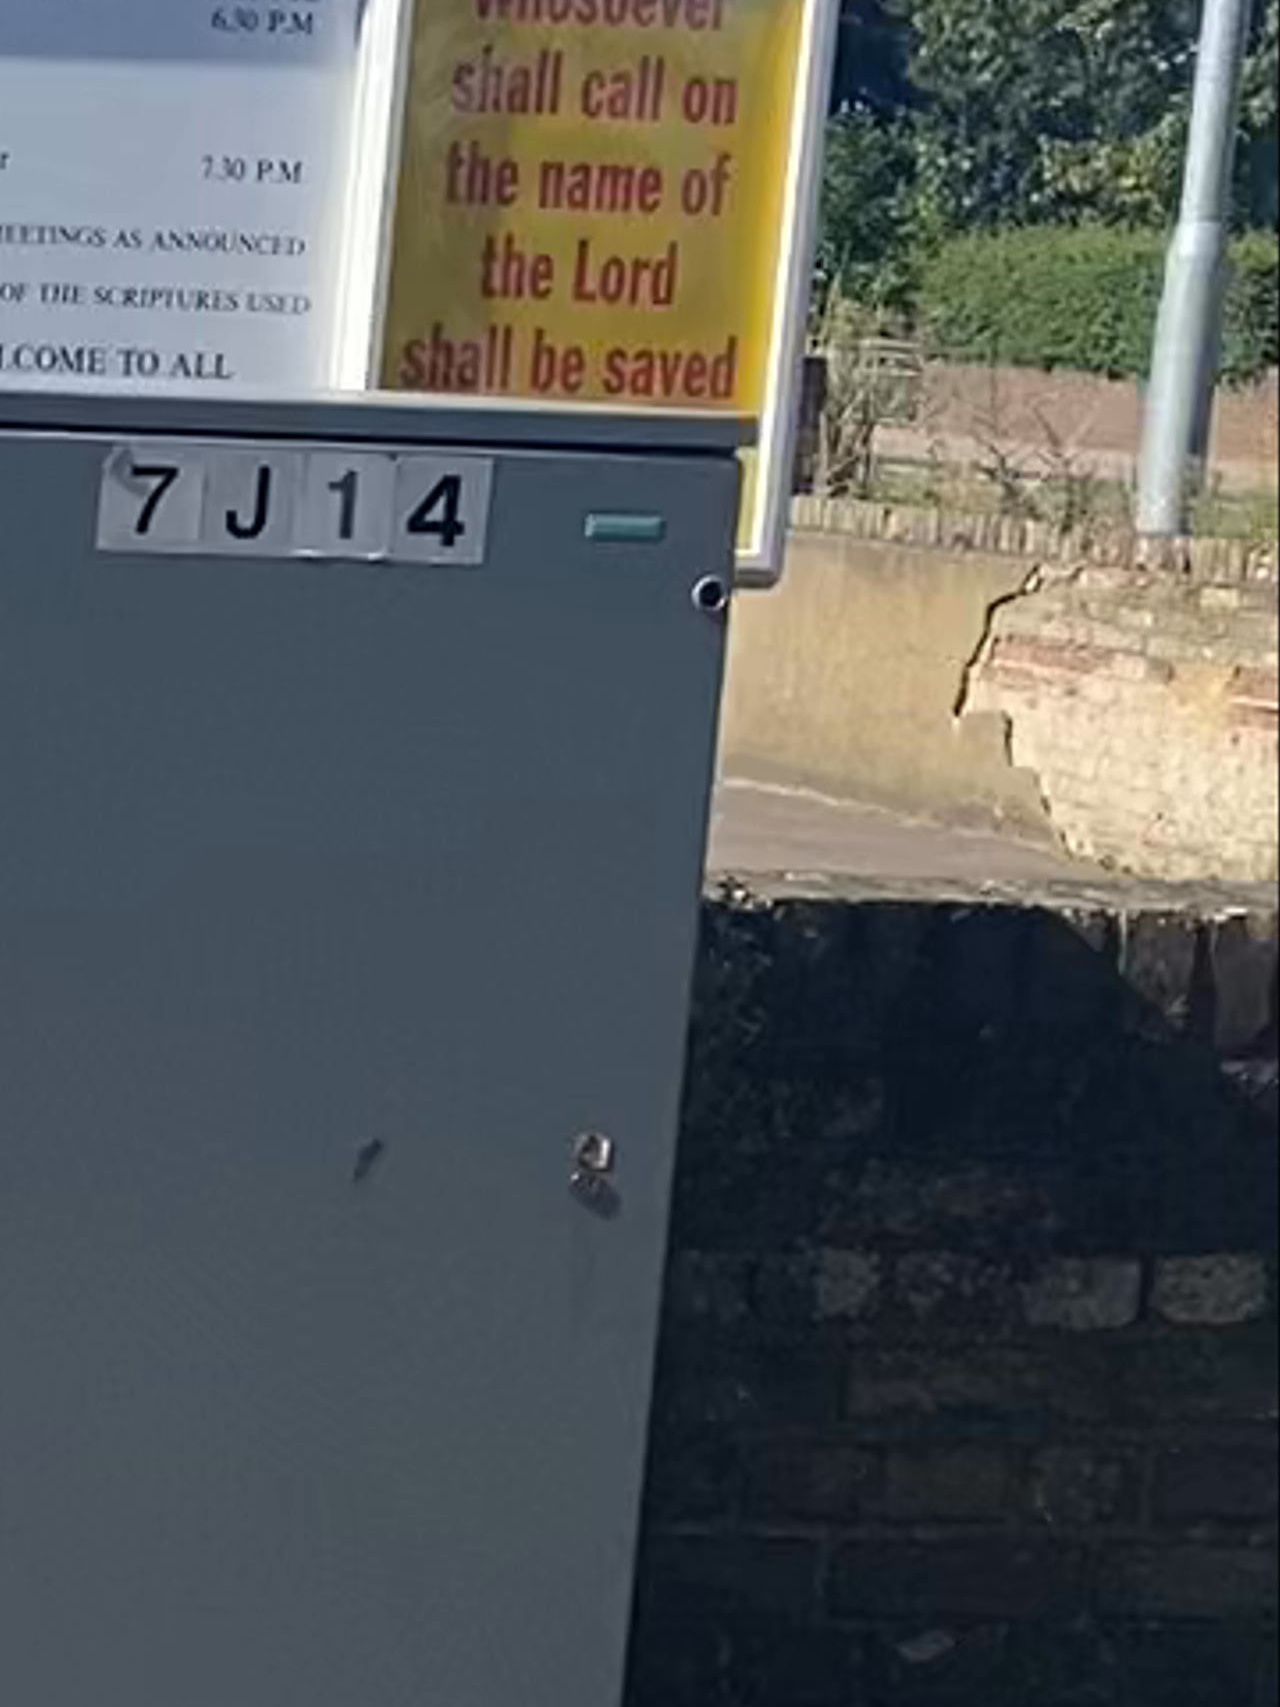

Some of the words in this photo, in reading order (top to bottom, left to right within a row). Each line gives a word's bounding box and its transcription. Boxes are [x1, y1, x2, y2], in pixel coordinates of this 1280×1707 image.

[453, 45, 563, 115] shall
[581, 55, 664, 121] call
[683, 76, 737, 125] on
[445, 140, 518, 205] the
[539, 159, 662, 214] name
[682, 153, 731, 217] of
[113, 229, 141, 248] AS
[151, 230, 305, 256] ANNOUNCED
[481, 233, 553, 300] the
[573, 239, 678, 305] Lord
[0, 282, 27, 303] OF
[40, 283, 79, 304] THE
[94, 287, 238, 311] SCRIPTURES
[246, 294, 311, 315] USED
[117, 349, 159, 376] TO
[169, 352, 232, 380] ALL
[400, 323, 512, 389] shall
[531, 328, 585, 394] be
[602, 336, 738, 400] saved
